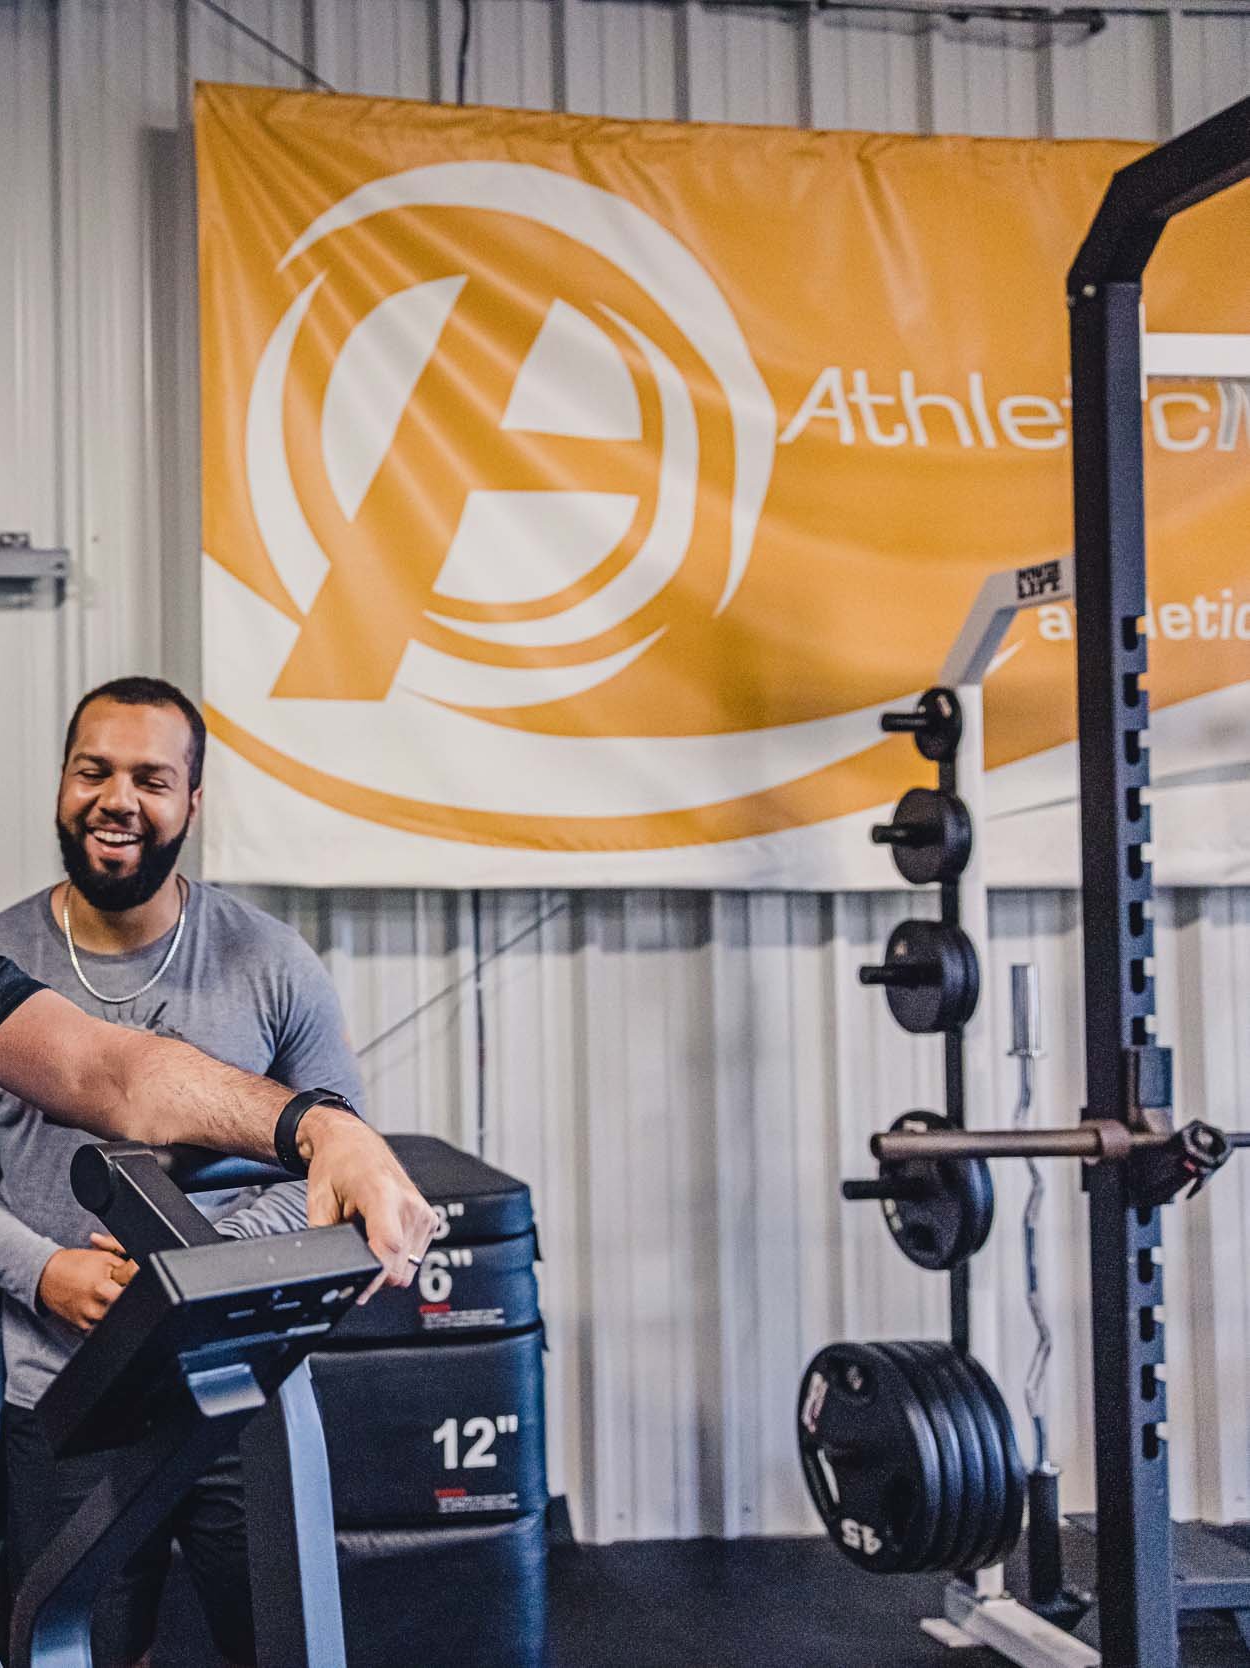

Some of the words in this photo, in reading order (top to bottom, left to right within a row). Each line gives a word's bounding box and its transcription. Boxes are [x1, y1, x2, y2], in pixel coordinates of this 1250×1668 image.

[779, 366, 1250, 452] Athlec
[418, 1248, 473, 1303] 6"
[433, 1414, 519, 1470] 12"
